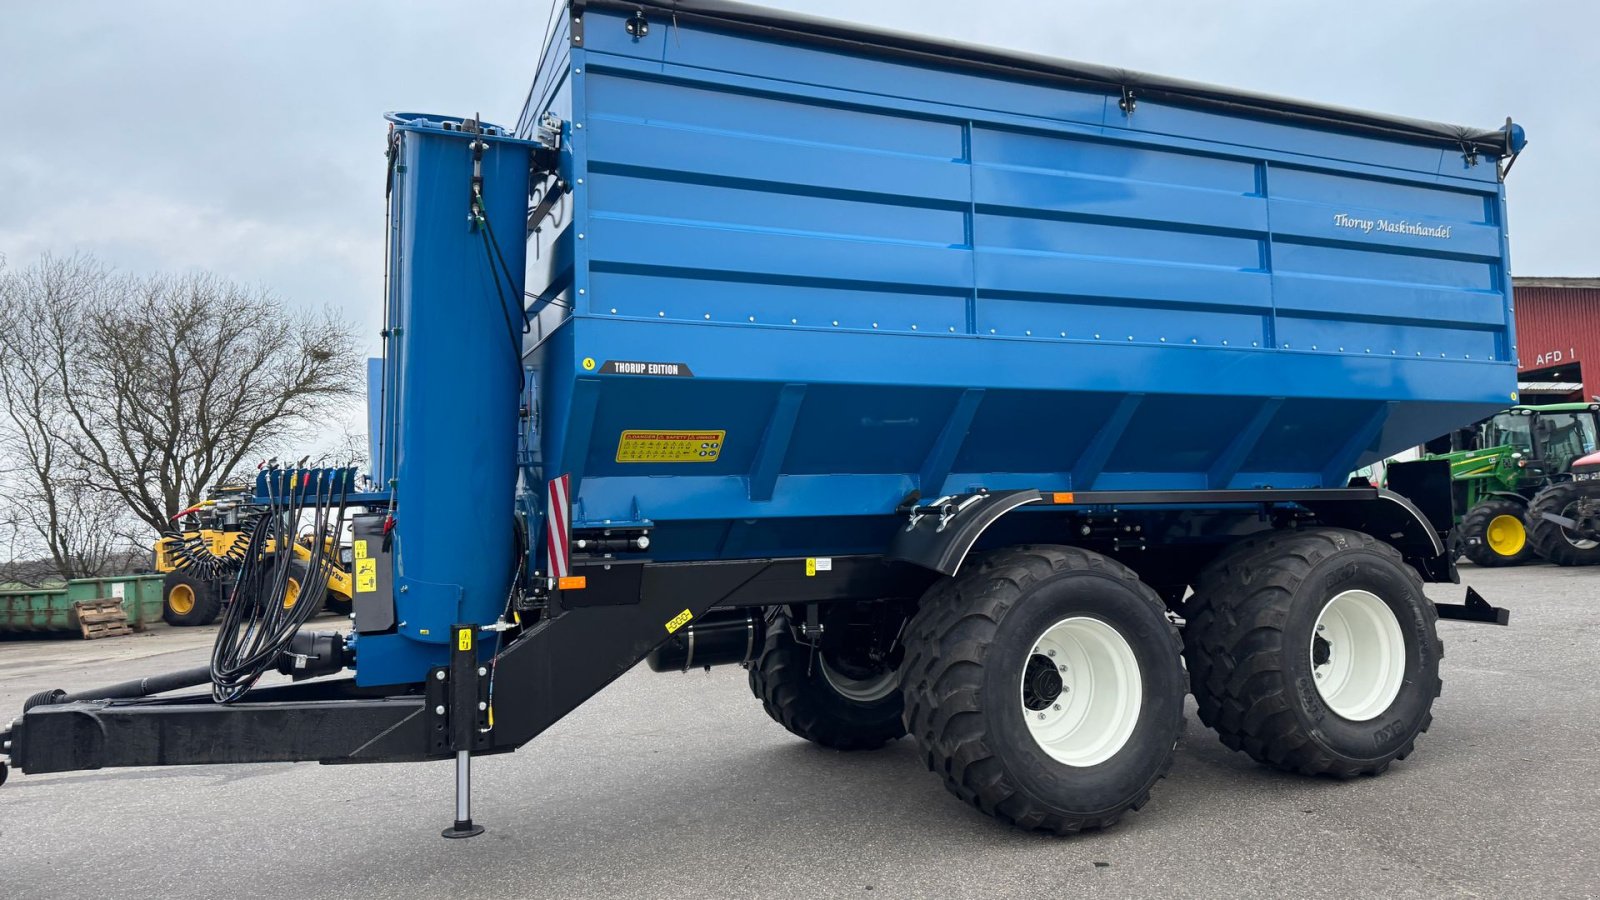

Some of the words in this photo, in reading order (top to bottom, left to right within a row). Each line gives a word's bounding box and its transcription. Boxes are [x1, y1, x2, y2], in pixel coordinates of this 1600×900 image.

[1333, 213, 1374, 234] Thorup
[1377, 219, 1452, 238] Maskinhandel
[1536, 351, 1562, 365] AFD
[614, 362, 646, 374] THORUP
[648, 363, 679, 375] EDITION
